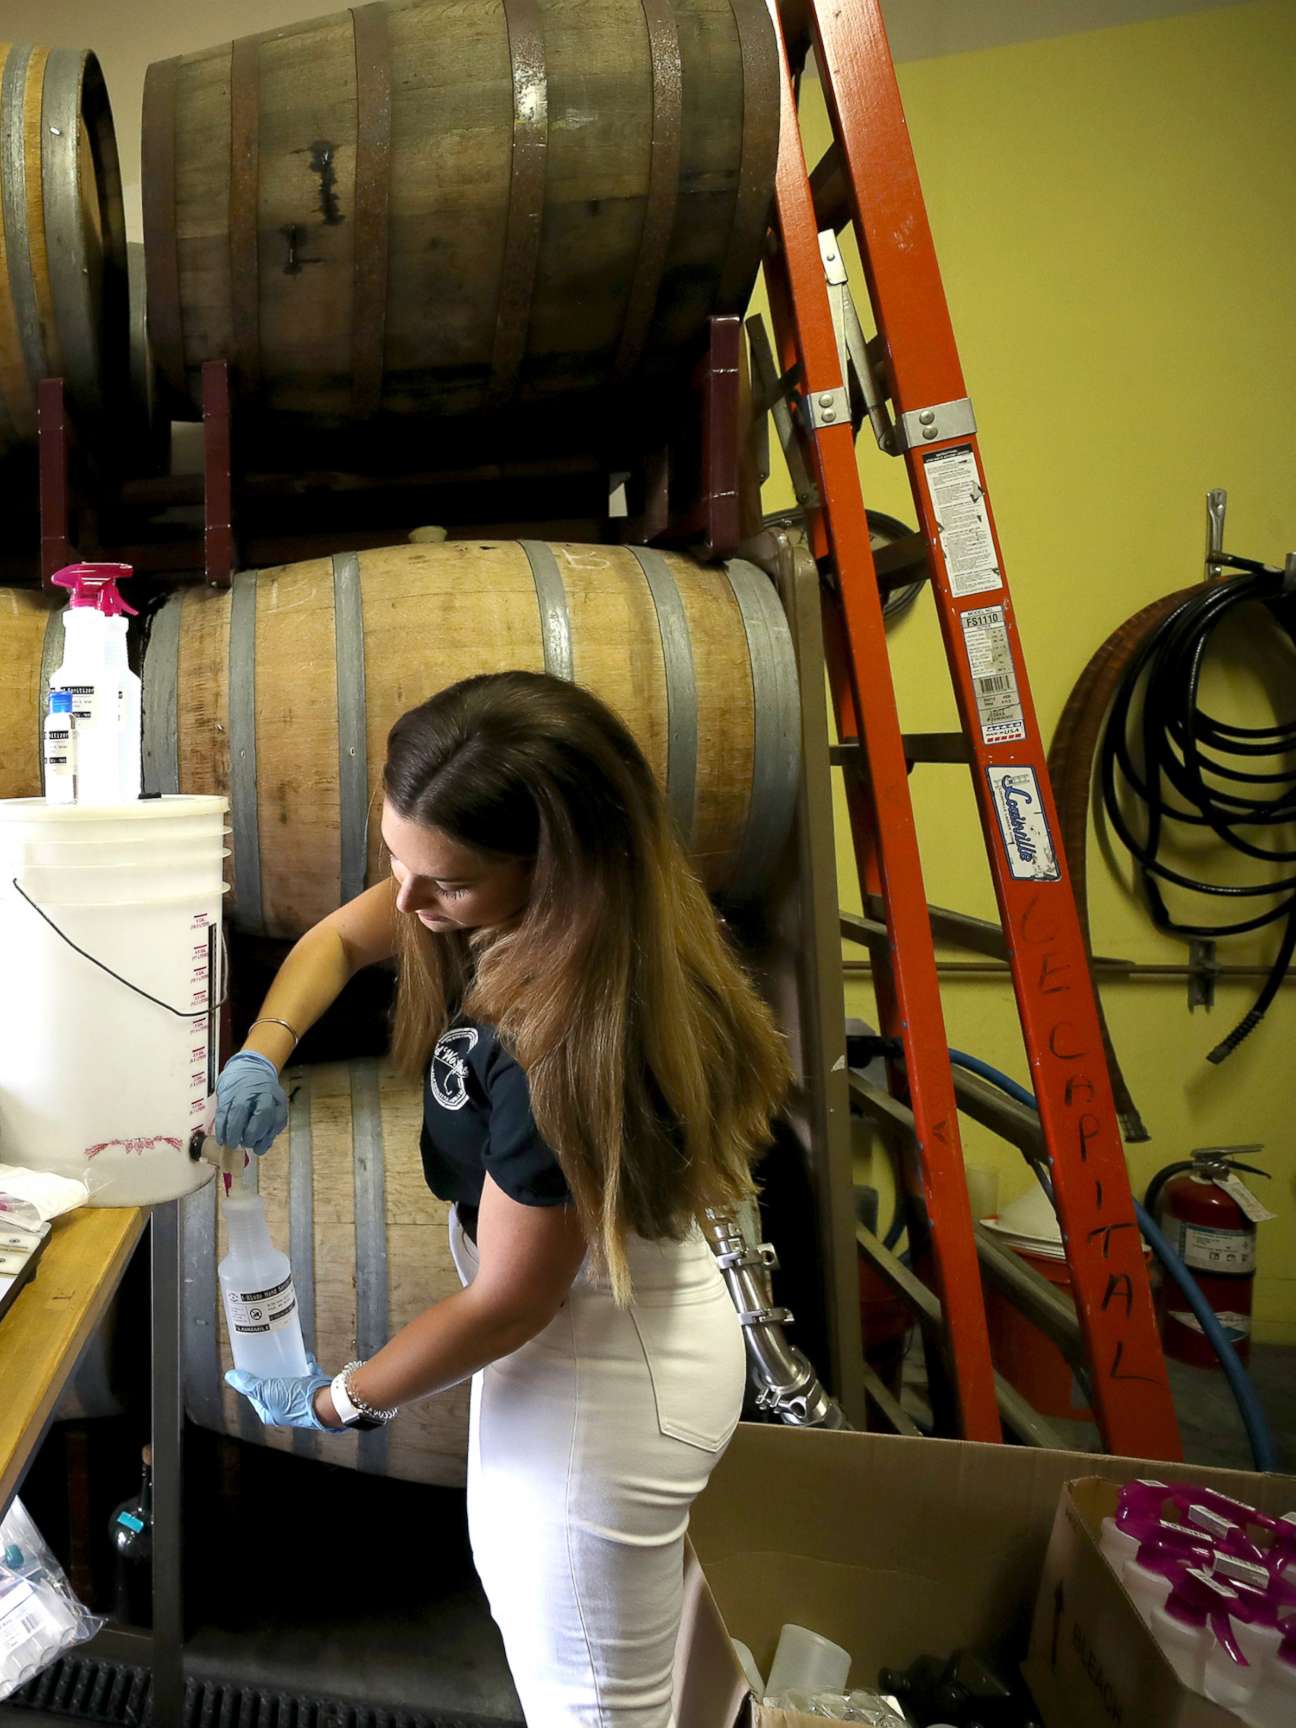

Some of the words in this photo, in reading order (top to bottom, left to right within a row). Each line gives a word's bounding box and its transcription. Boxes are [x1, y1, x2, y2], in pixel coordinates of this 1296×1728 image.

[966, 613, 998, 628] FS1110
[1002, 775, 1037, 862] Louisville
[1049, 1022, 1158, 1384] CAPITAL
